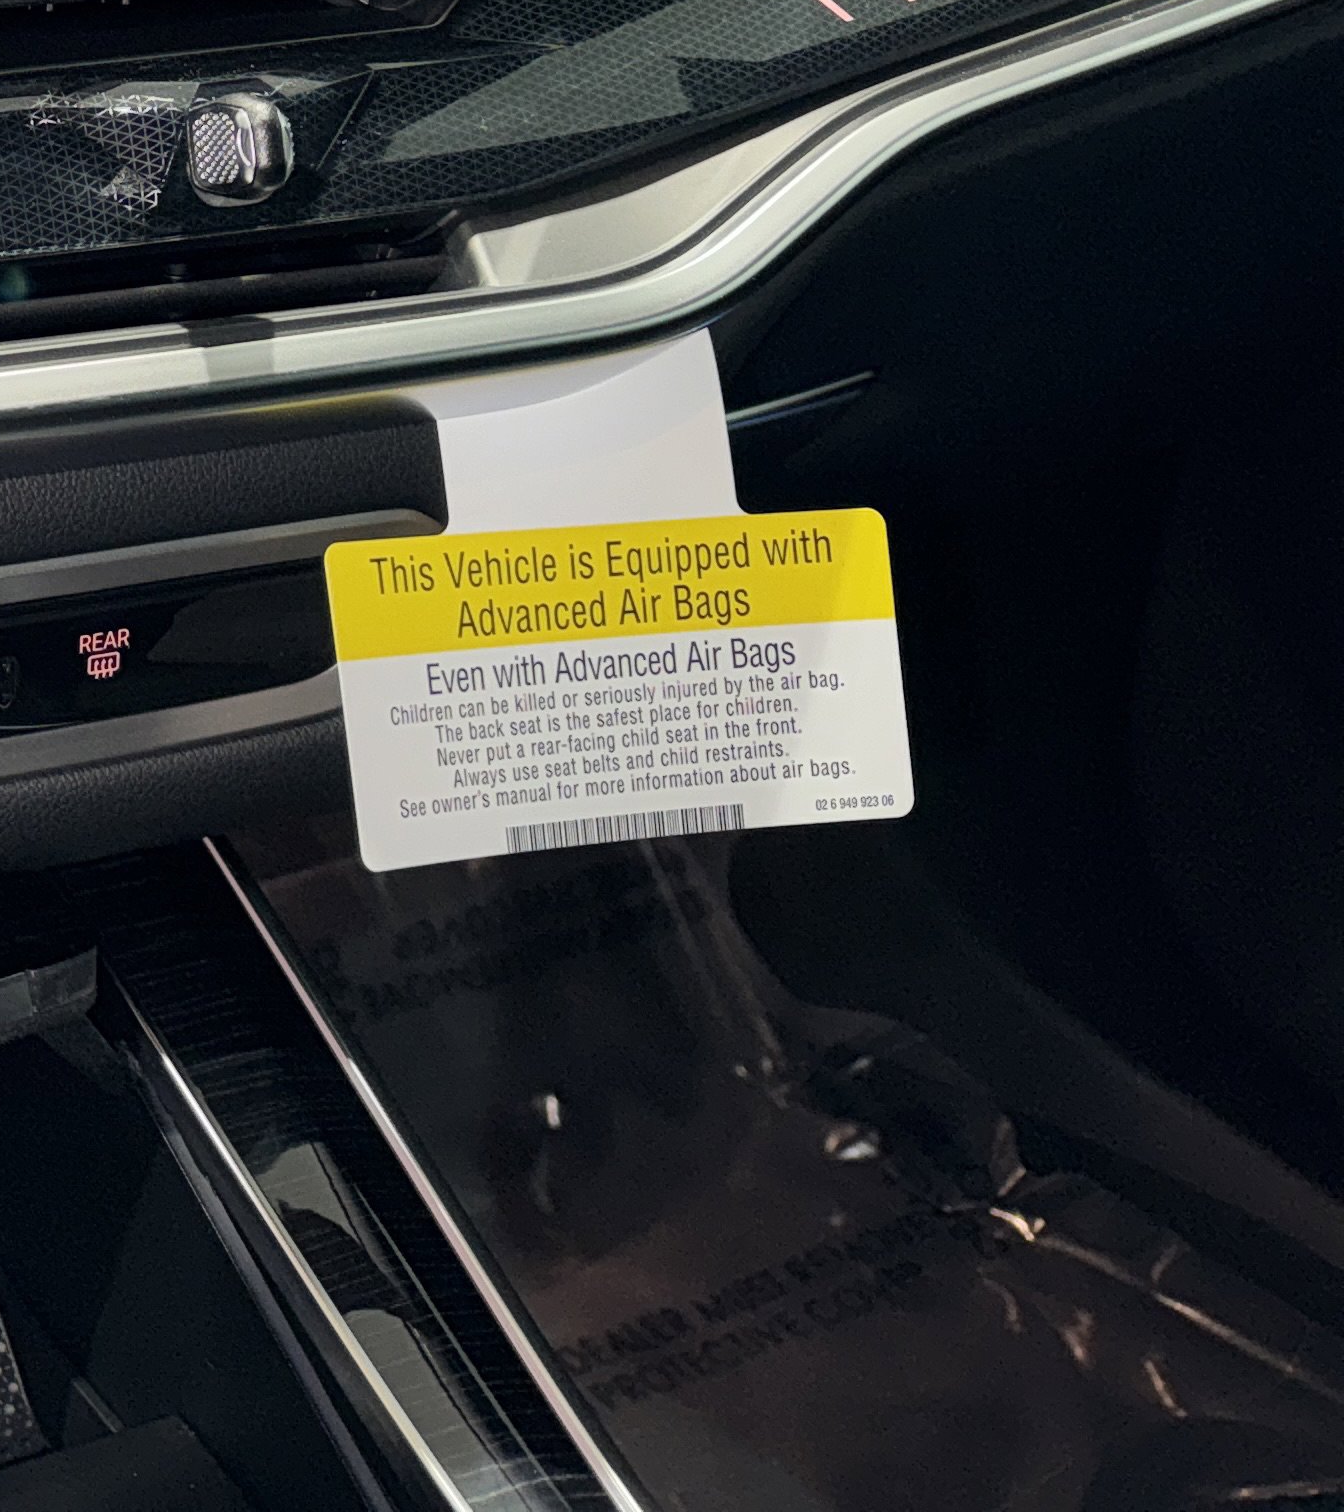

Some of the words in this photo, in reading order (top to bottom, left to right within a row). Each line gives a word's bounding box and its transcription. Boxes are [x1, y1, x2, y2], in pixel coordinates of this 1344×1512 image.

[369, 555, 435, 595] This
[443, 546, 557, 589] Vehicle
[568, 543, 595, 580] is
[606, 531, 750, 583] Equipped
[762, 527, 833, 566] with
[457, 590, 607, 639] Advanced
[619, 587, 662, 625] Air
[673, 584, 751, 626] Bags
[79, 628, 130, 654] REAR
[426, 662, 485, 695] Even
[493, 653, 546, 689] with
[555, 642, 677, 684] Advanced
[687, 640, 722, 673] Air
[730, 637, 796, 673] Bags
[390, 702, 453, 726] Children
[458, 700, 485, 718] can
[491, 696, 509, 716] be
[515, 691, 556, 713] killed
[562, 692, 579, 708] or
[584, 683, 656, 706] seriously
[662, 677, 717, 703] injured
[724, 675, 743, 697] by
[749, 674, 774, 693] the
[781, 672, 802, 691] air
[808, 670, 845, 692] bag.
[435, 724, 464, 744] The
[469, 719, 506, 740] back
[510, 716, 543, 736] seat
[547, 714, 561, 732] is
[566, 712, 591, 731] the
[596, 707, 644, 727] safest
[650, 704, 691, 726] place
[696, 701, 720, 719] for
[726, 696, 799, 717] children.
[436, 747, 480, 767] Never
[486, 741, 512, 765] put
[516, 743, 526, 759] a
[531, 732, 616, 757] rear-facing
[621, 727, 660, 748] child
[666, 724, 698, 744] seat
[704, 722, 719, 741] in
[724, 720, 750, 739] the
[756, 716, 803, 736] front.
[454, 768, 507, 789] Always
[512, 766, 539, 782] use
[545, 757, 578, 778] seat
[582, 754, 620, 774] belts
[626, 749, 654, 770] and
[661, 747, 699, 768] child
[705, 740, 790, 763] restraints.
[400, 799, 427, 819] See
[432, 789, 491, 815] owner's
[496, 782, 552, 807] manual
[556, 780, 579, 800] for
[585, 778, 625, 797] more
[630, 769, 724, 793] information
[730, 761, 777, 784] about
[782, 760, 804, 780] air
[810, 758, 856, 780] bags.
[815, 798, 828, 811] 02
[830, 797, 837, 810] 6
[839, 796, 858, 809] 949
[860, 795, 879, 808] 923
[881, 794, 895, 807] 06
